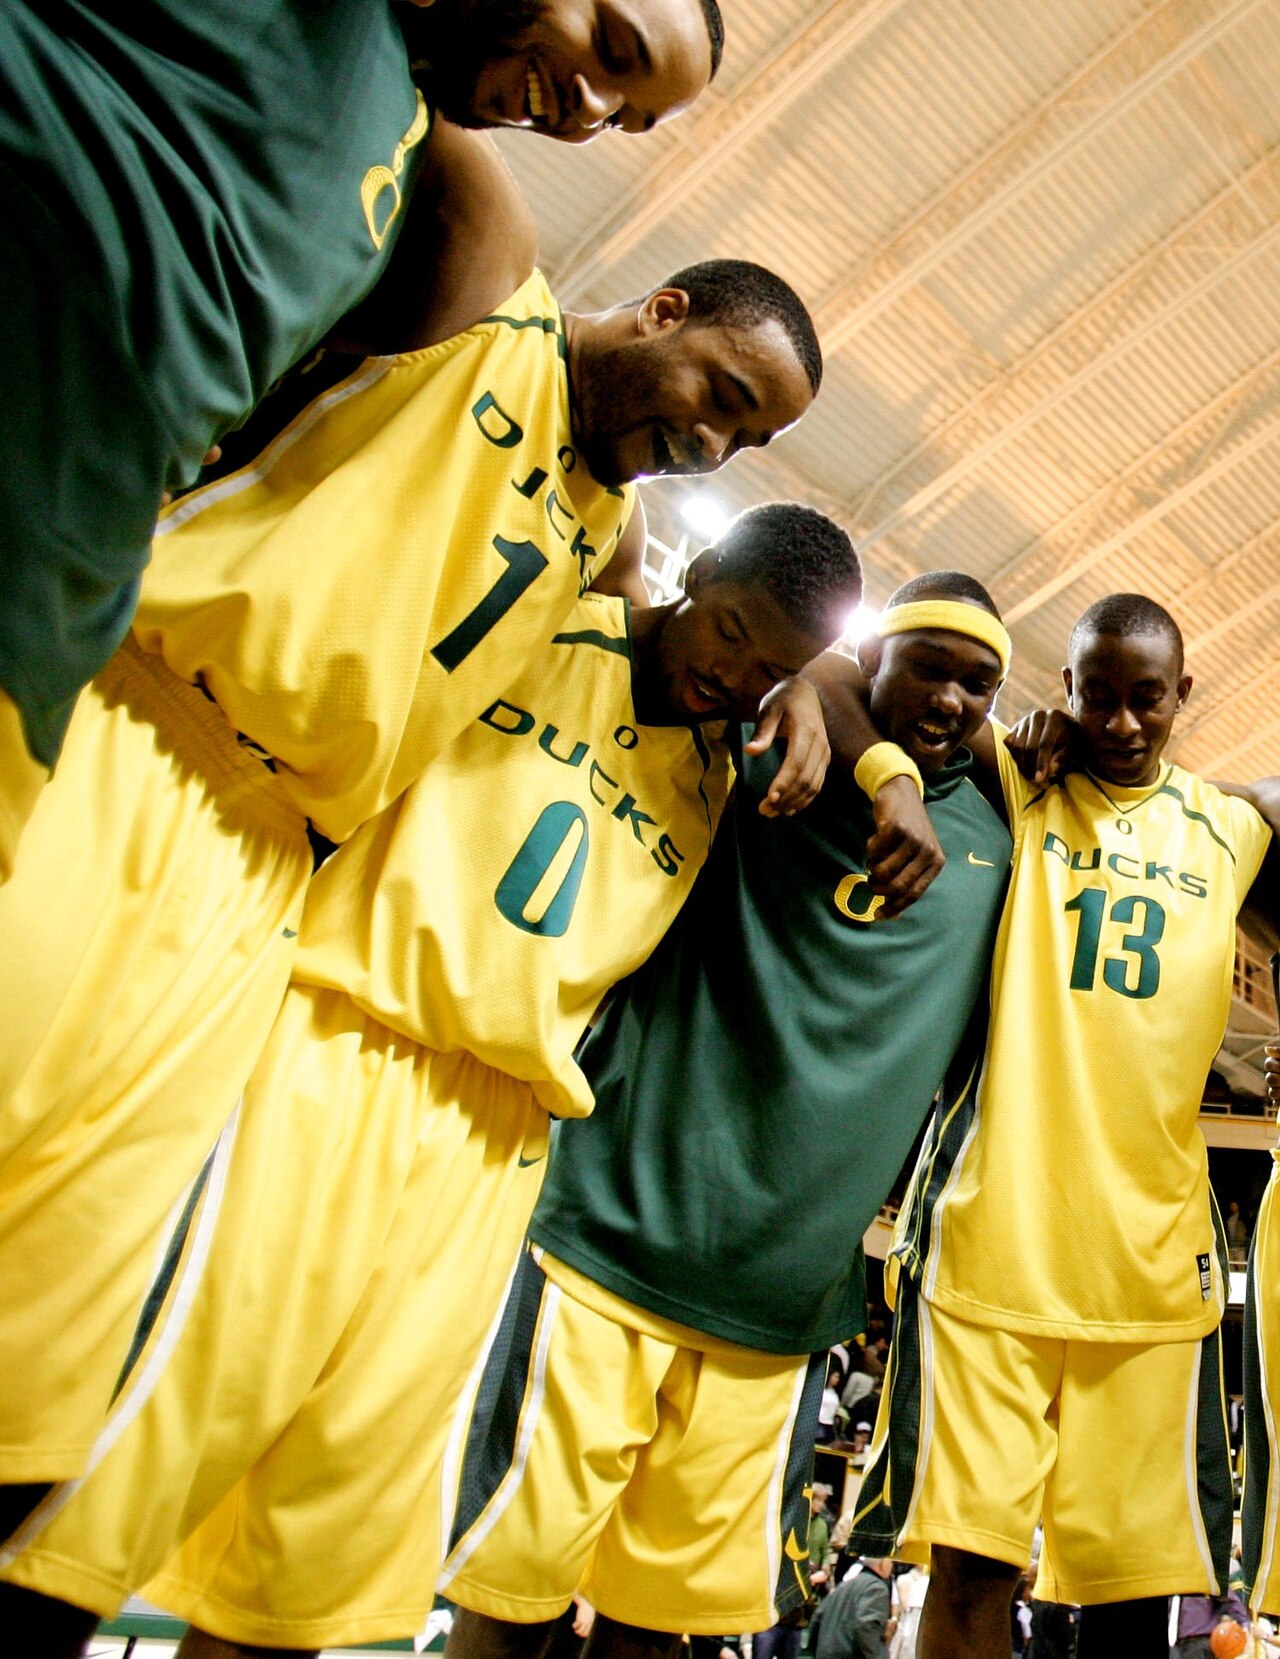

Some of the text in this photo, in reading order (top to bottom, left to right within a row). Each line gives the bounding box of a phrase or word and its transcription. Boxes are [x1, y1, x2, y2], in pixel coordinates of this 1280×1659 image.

[430, 534, 549, 674] 1
[478, 698, 685, 877] DUCKS
[613, 725, 639, 750] O
[494, 800, 590, 938] 0
[1043, 831, 1208, 898] DUCKS
[1115, 818, 1133, 835] O
[1064, 887, 1166, 1000] 13
